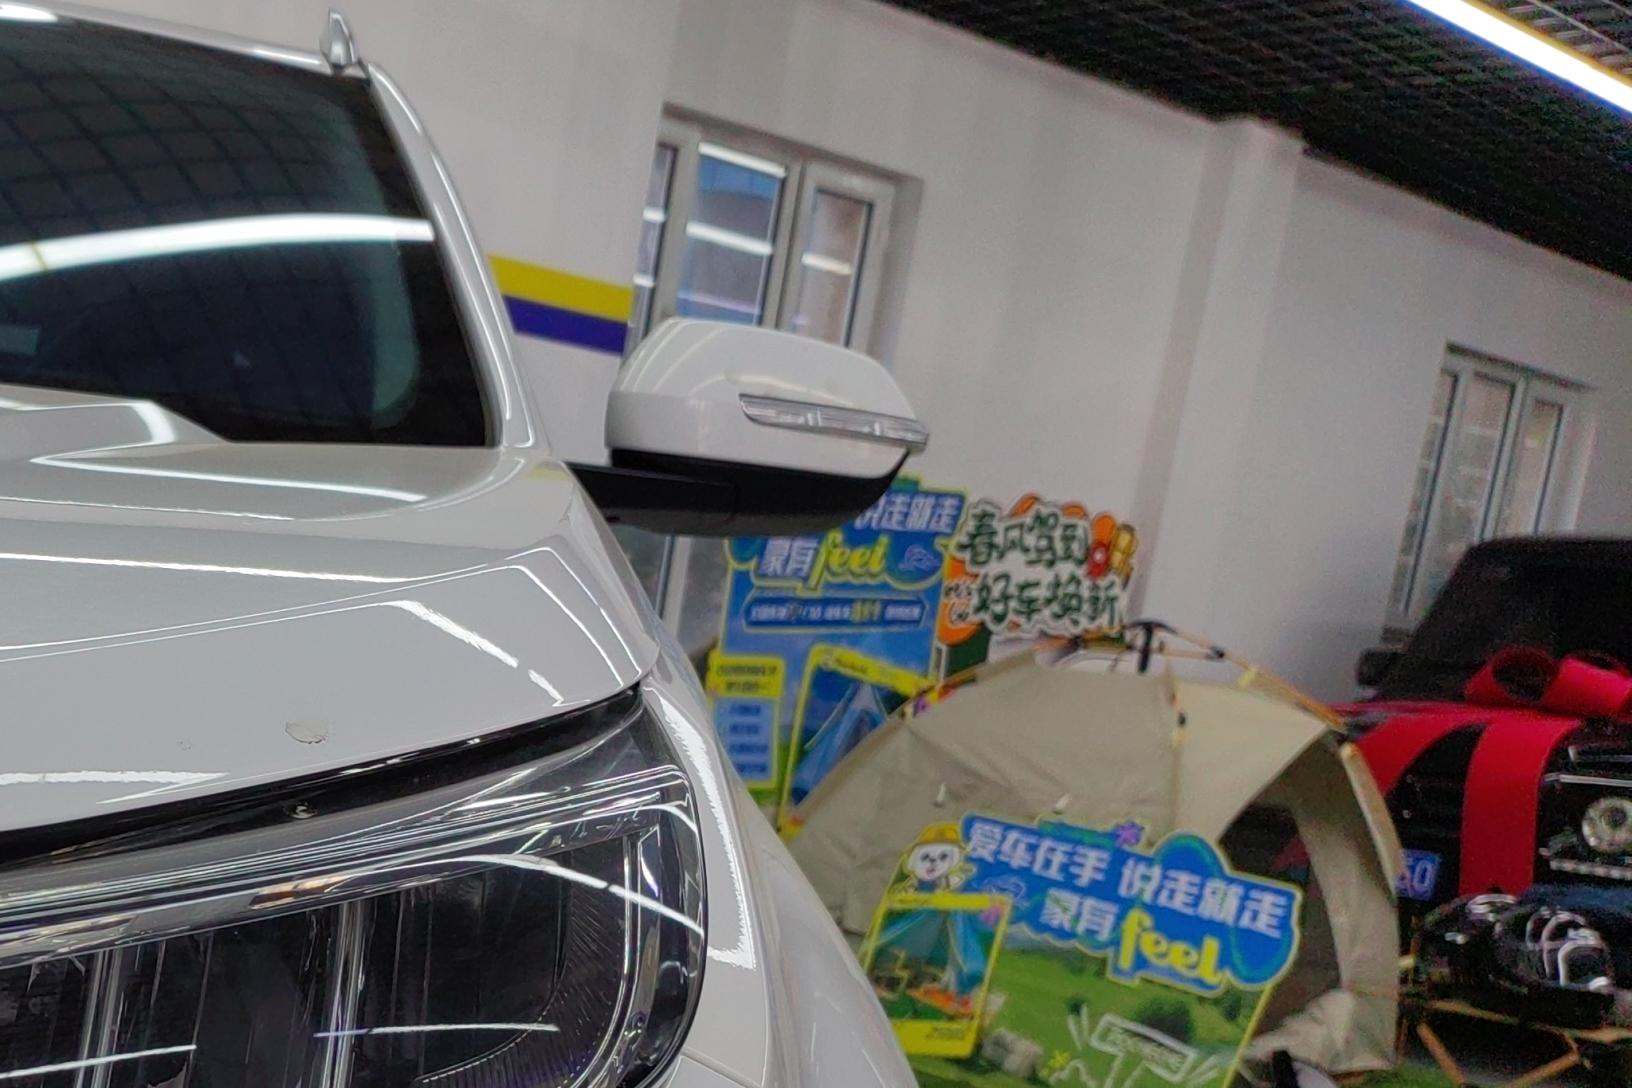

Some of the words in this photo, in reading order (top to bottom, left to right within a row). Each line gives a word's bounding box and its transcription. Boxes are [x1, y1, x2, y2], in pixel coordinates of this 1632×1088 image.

[808, 529, 889, 590] feel
[956, 507, 1089, 568] 春风驾到
[967, 820, 1111, 886] 爱车在手
[1118, 856, 1289, 939] 说走就走
[1117, 907, 1229, 988] feel
